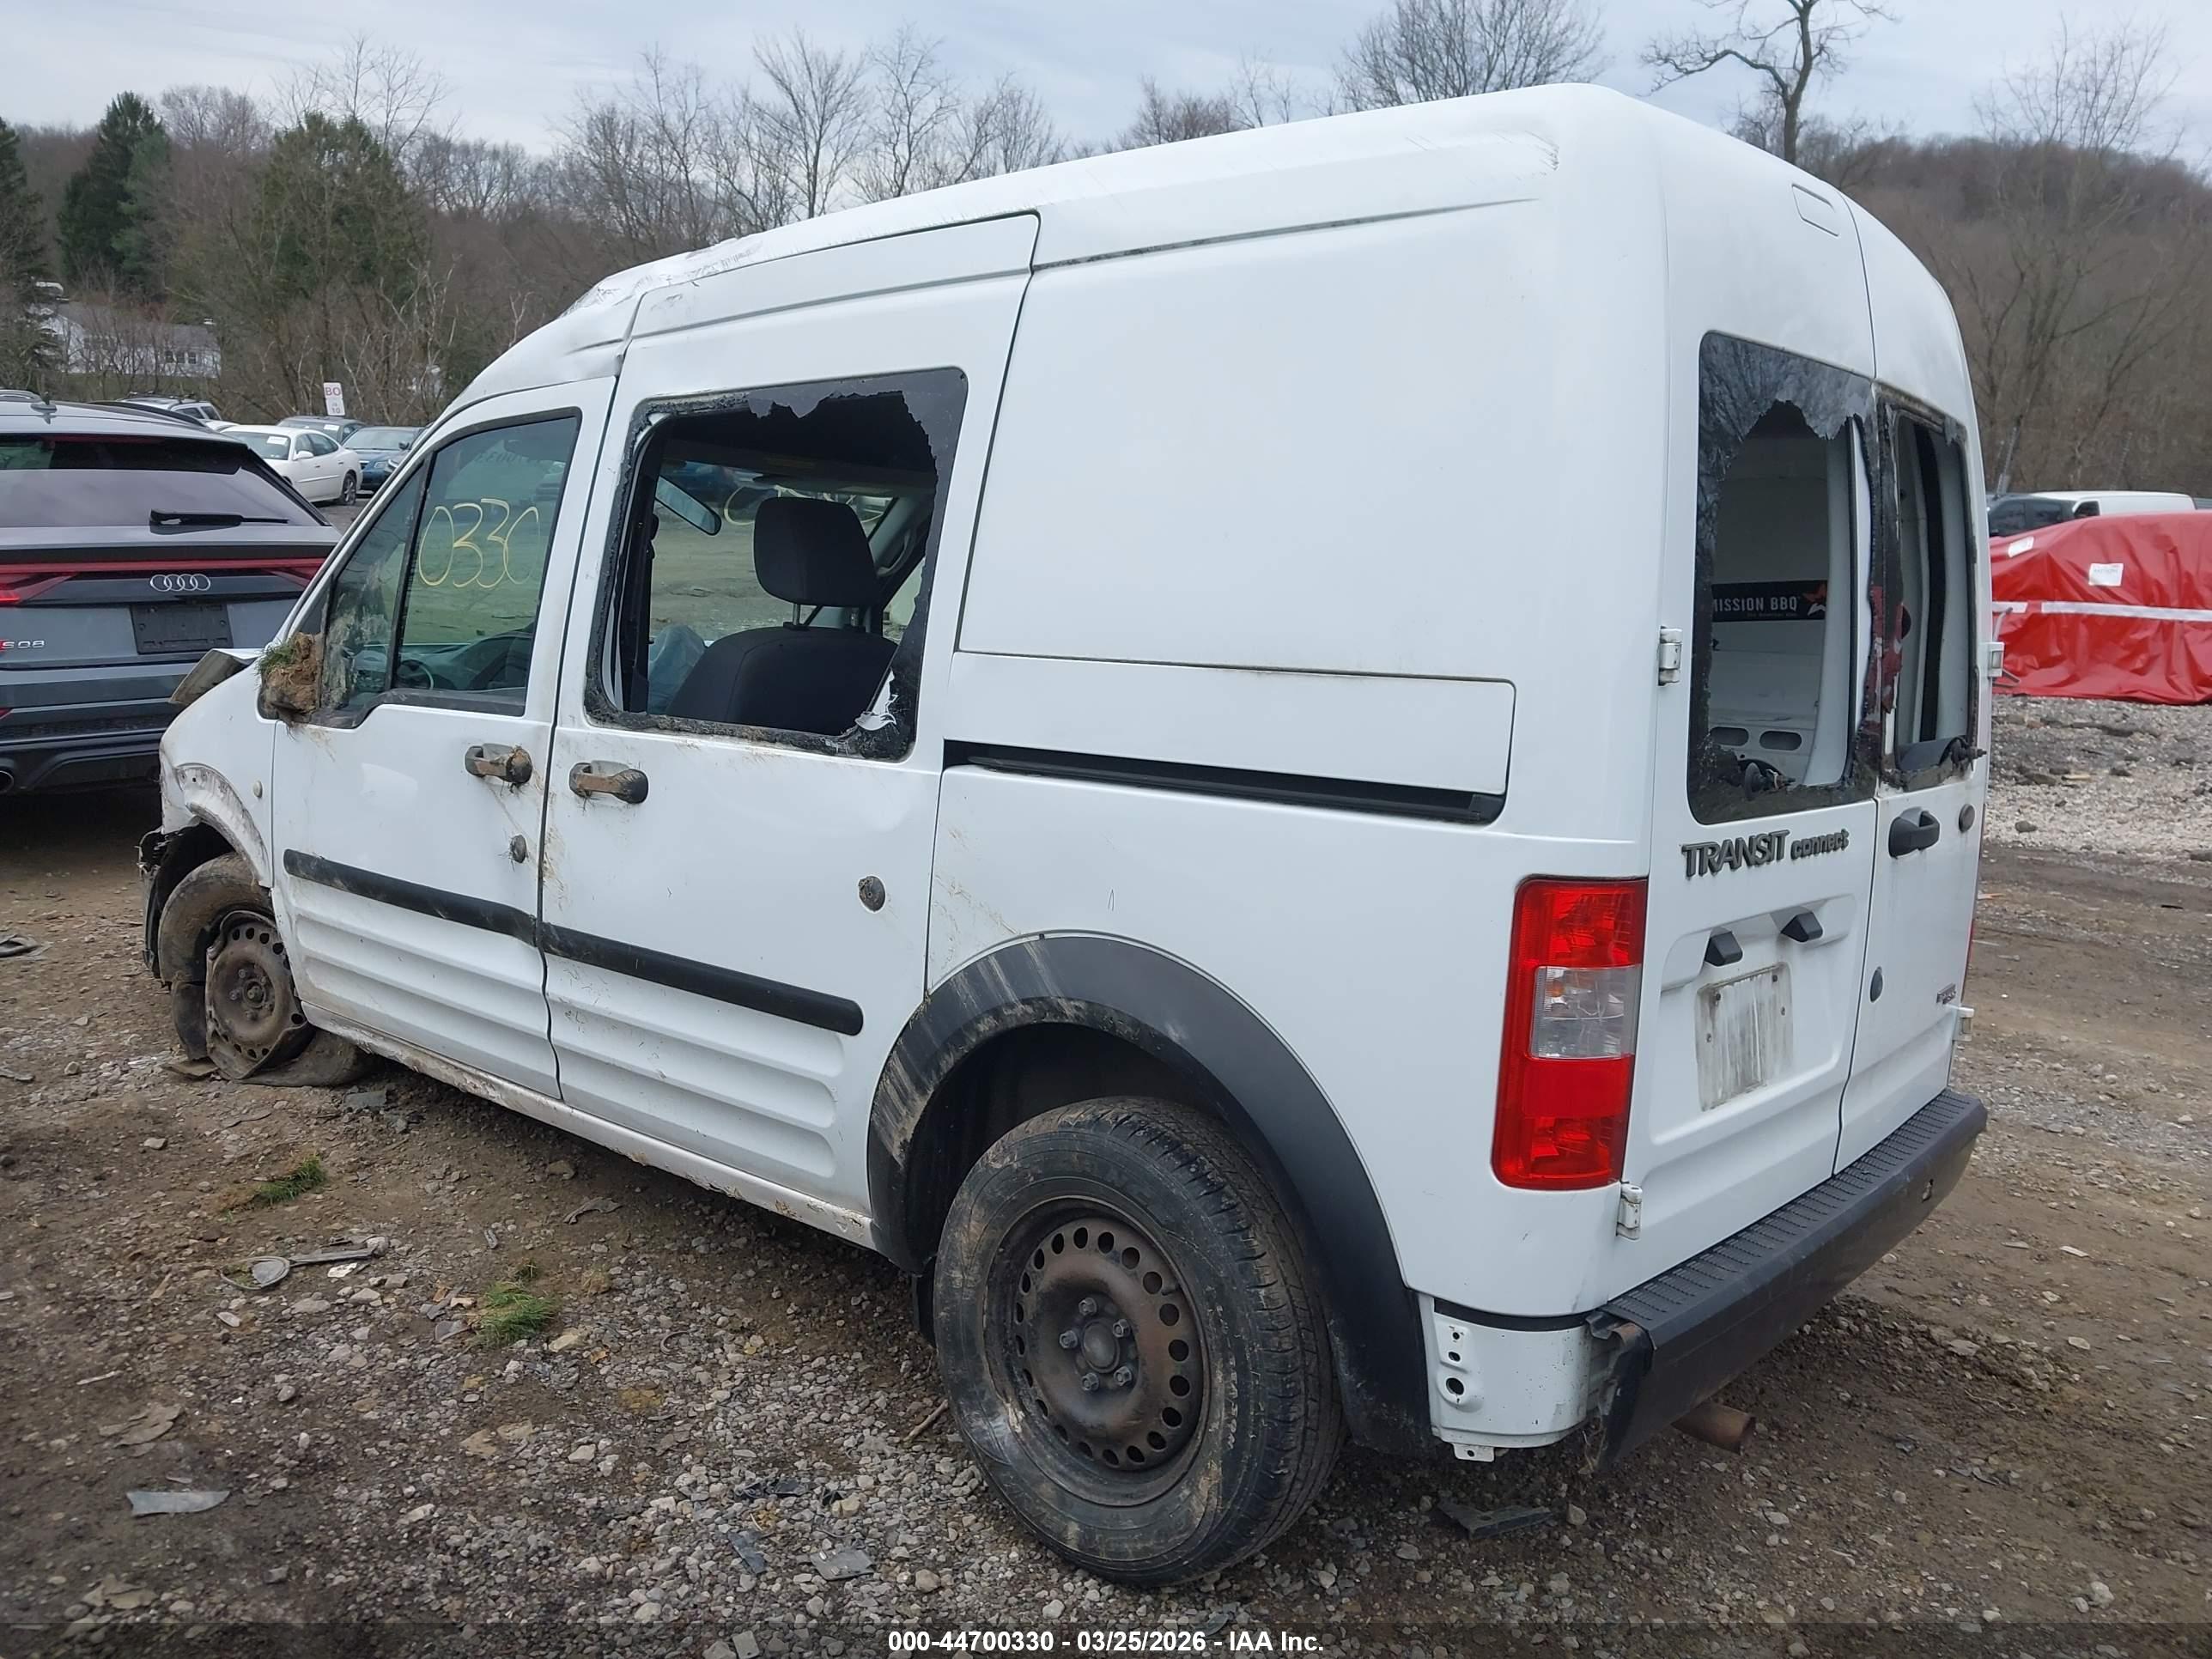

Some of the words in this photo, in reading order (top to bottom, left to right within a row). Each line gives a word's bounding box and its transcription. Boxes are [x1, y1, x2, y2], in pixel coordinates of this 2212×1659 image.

[418, 497, 540, 588] 0330
[1770, 596, 1797, 611] BBQ
[2, 640, 45, 649] SQ8
[1681, 830, 1790, 878] TRANSIT
[1791, 829, 1850, 860] connect
